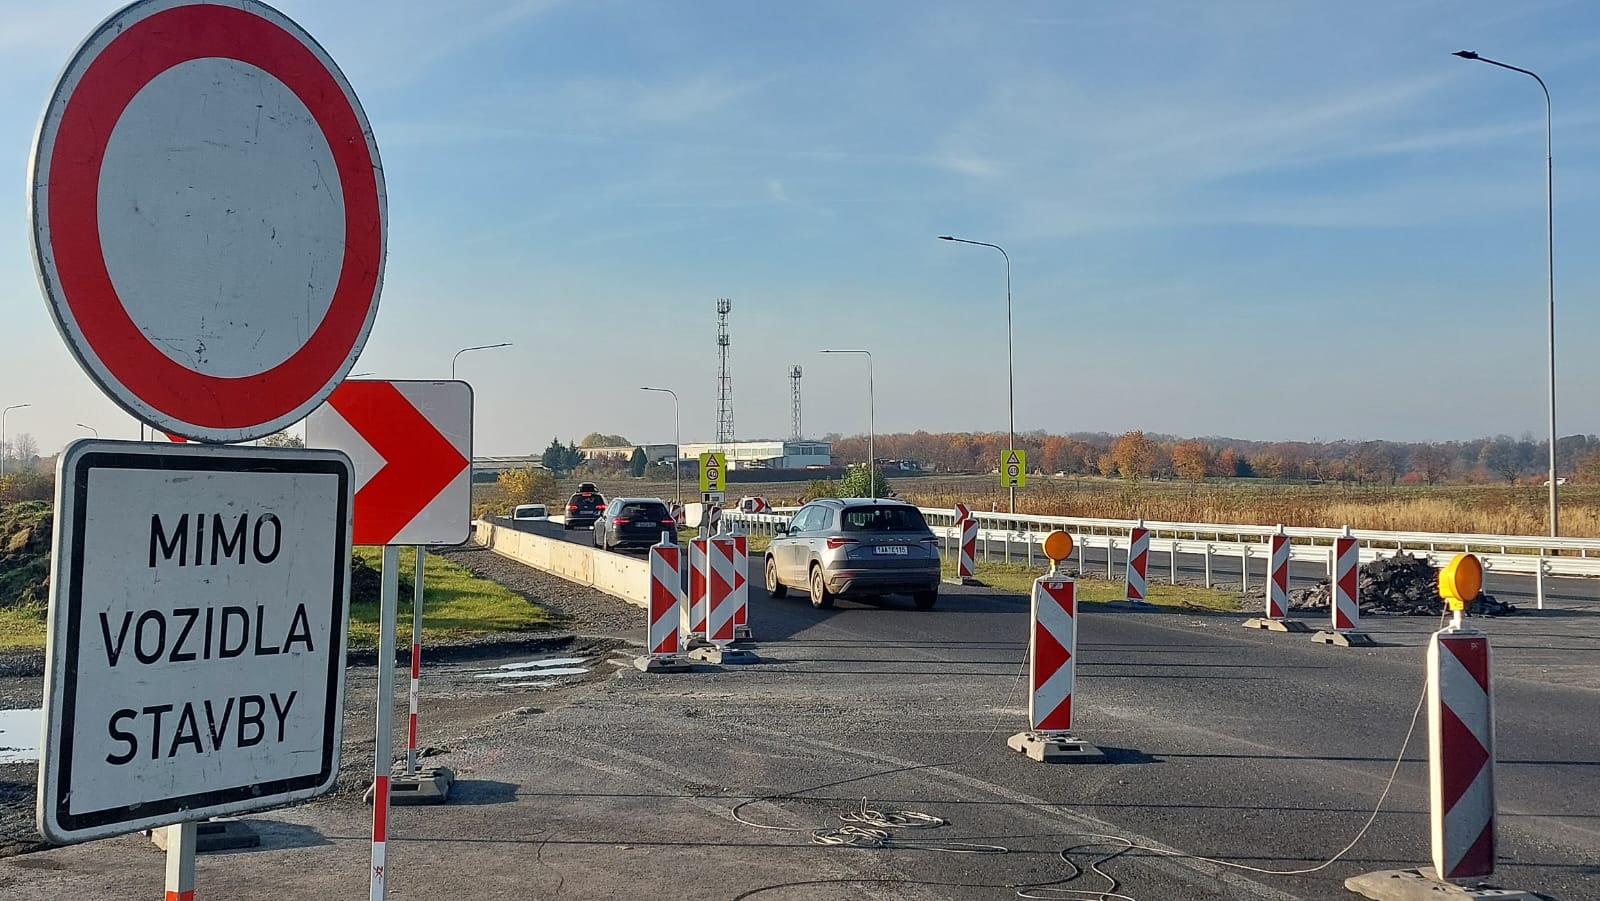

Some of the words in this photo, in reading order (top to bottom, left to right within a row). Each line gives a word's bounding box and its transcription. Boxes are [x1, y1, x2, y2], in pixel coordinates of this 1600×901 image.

[148, 512, 283, 569] MIMO
[98, 602, 315, 668] VOZIDLA
[105, 690, 298, 766] STAVBY
